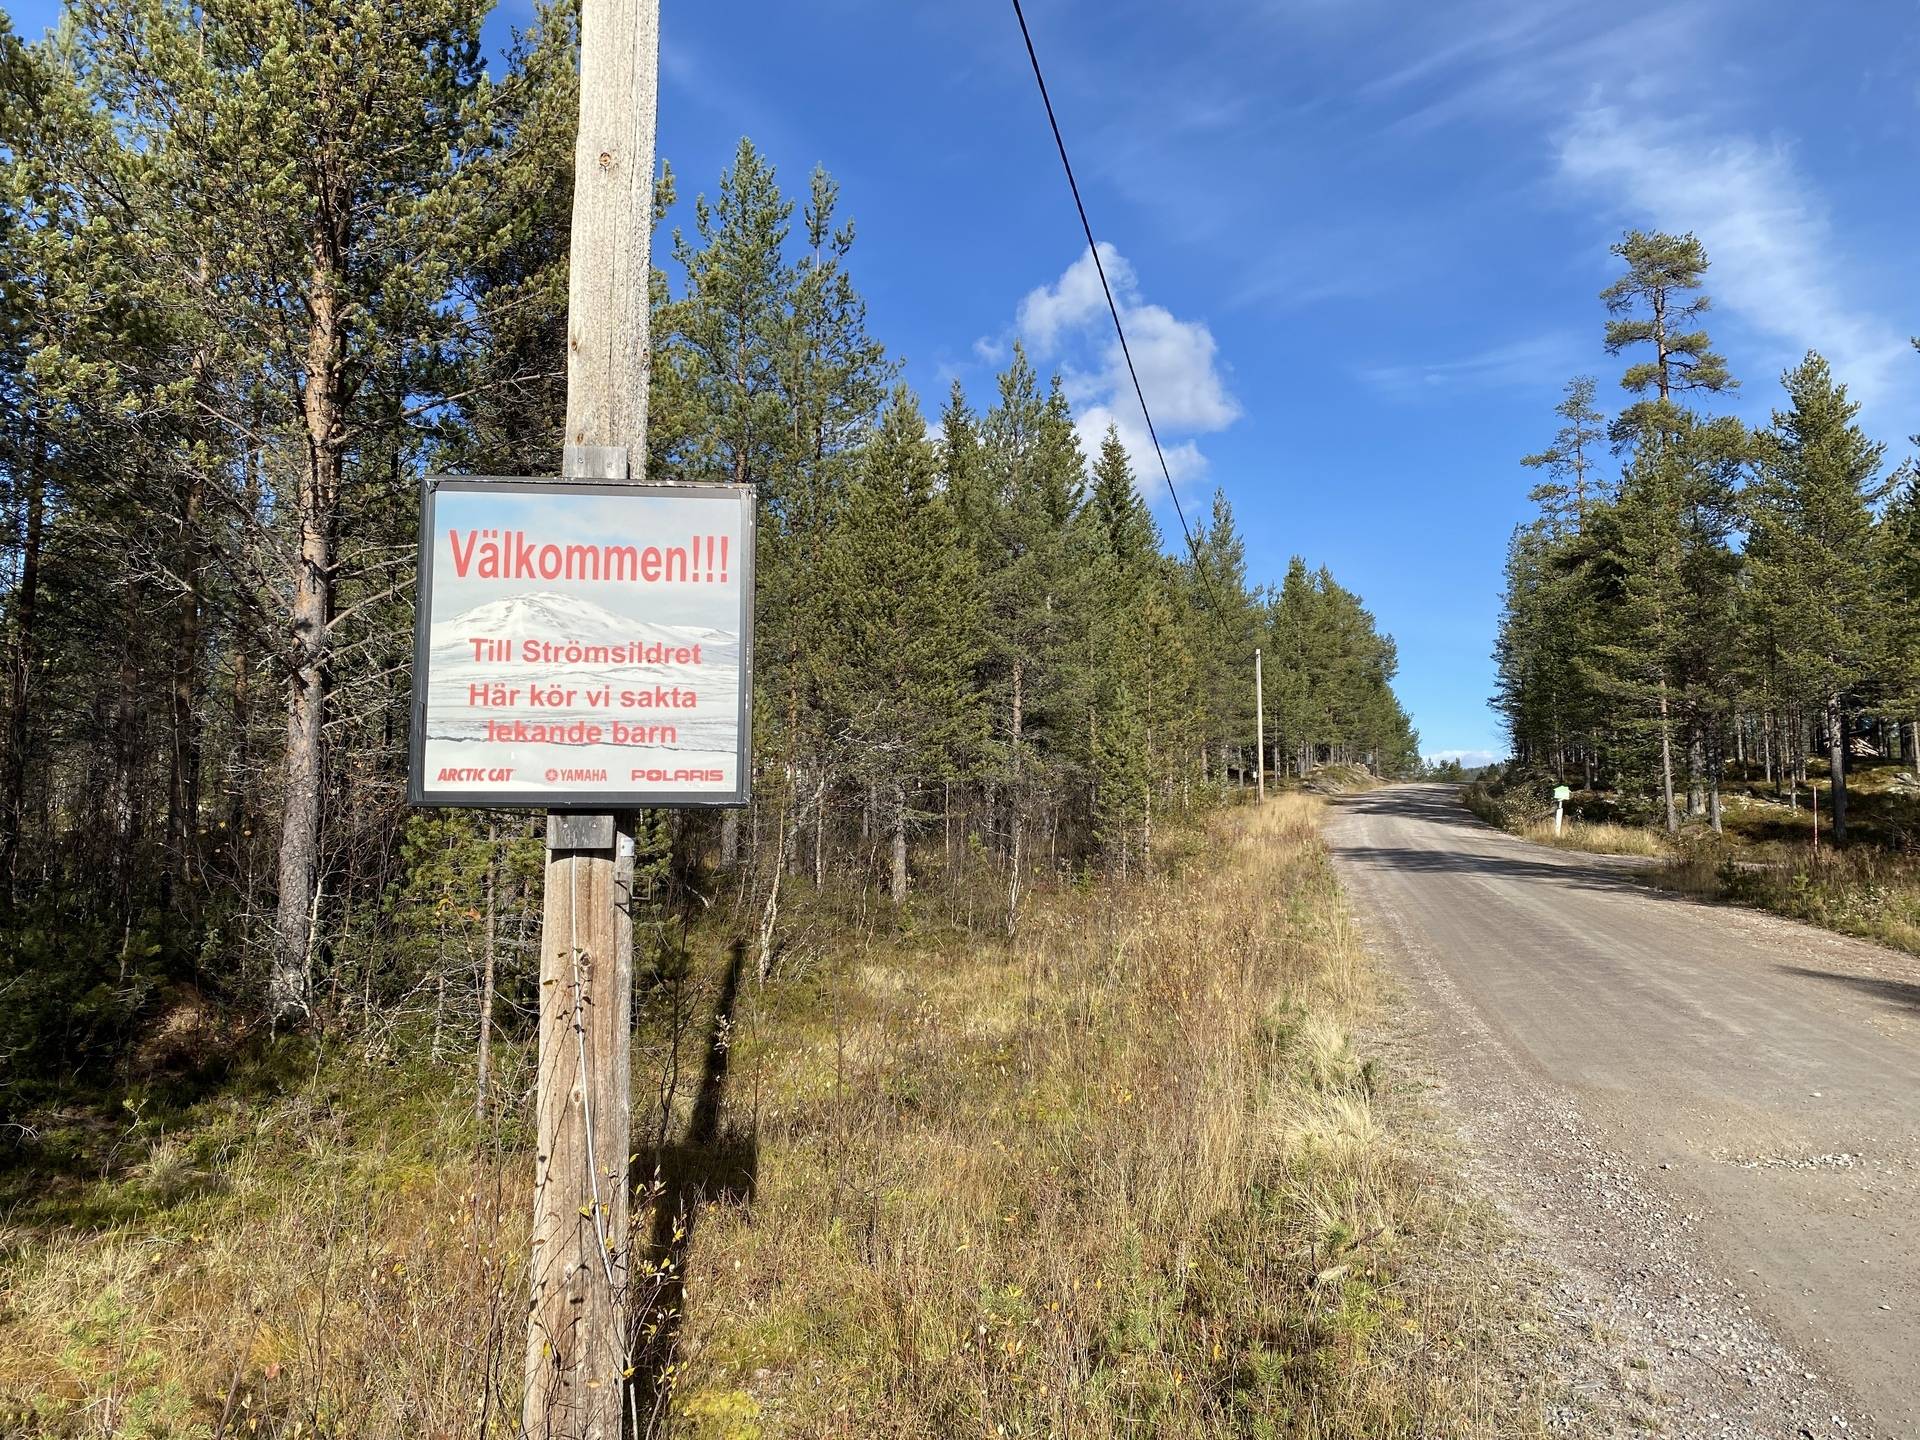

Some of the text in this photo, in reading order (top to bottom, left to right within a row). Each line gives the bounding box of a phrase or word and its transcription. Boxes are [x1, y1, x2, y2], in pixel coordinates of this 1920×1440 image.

[449, 529, 729, 583] Välkommen!!!
[469, 638, 702, 665] Till Strömsildret
[469, 682, 697, 709] Här kör vi sakta
[488, 719, 678, 745] lekande barn
[437, 768, 513, 782] ARCTIC CAT
[559, 769, 608, 782] YAMAHA
[631, 769, 724, 782] POLARIS
